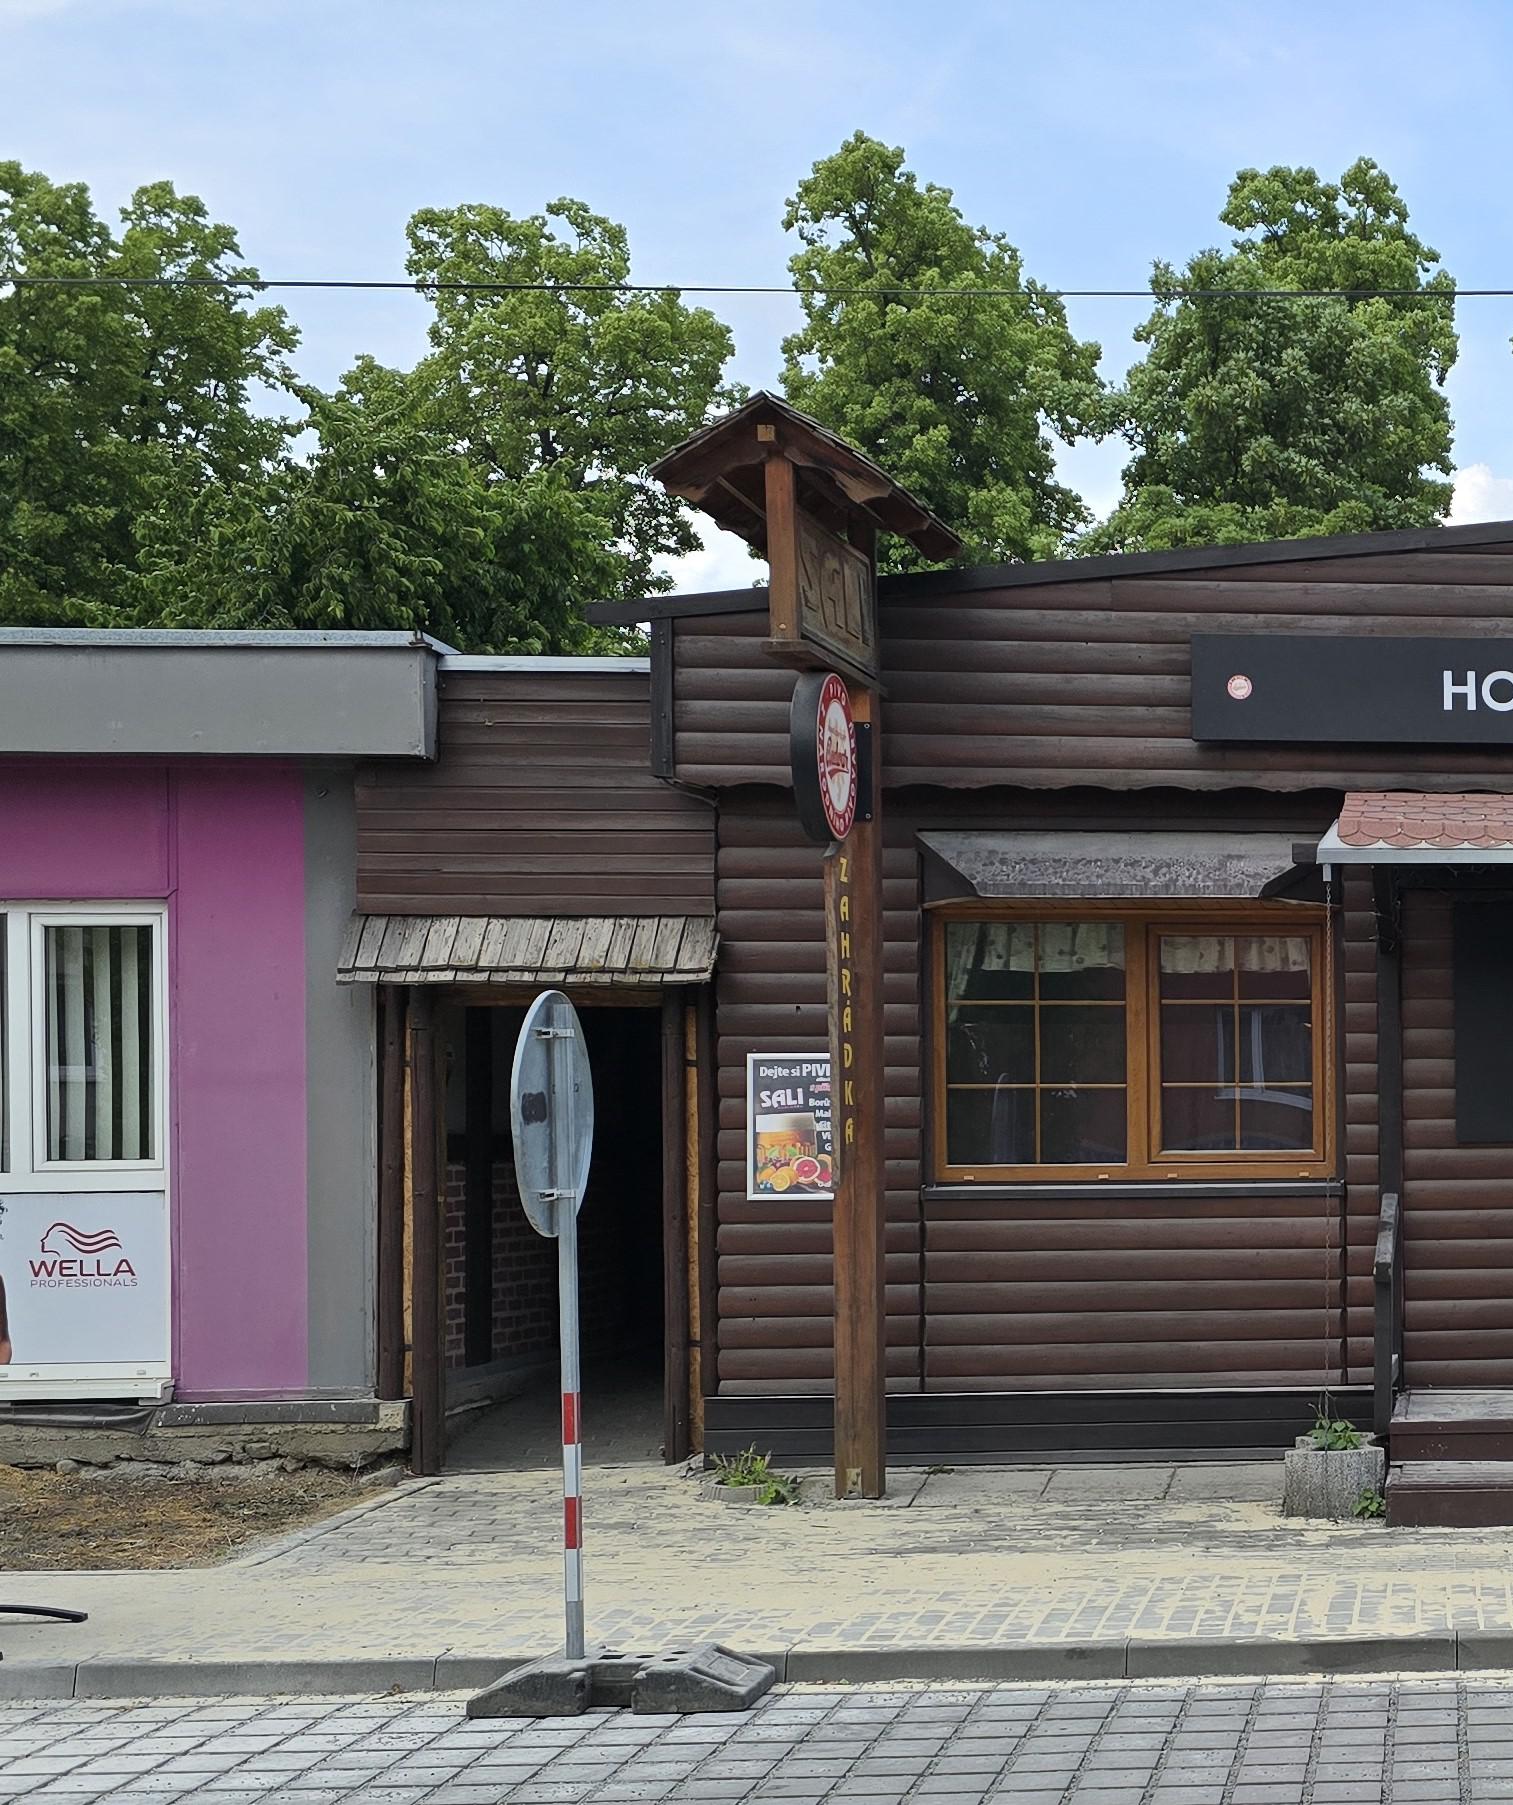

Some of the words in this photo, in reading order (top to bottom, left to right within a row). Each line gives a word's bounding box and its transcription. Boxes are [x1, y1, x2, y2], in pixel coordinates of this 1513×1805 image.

[829, 683, 846, 705] PIVO
[839, 856, 854, 1145] ZAHRÁDKA
[759, 1066, 790, 1079] Dejte
[790, 1065, 800, 1077] si
[29, 1259, 136, 1277] WELLA
[30, 1278, 138, 1288] PROFESSIONALS
